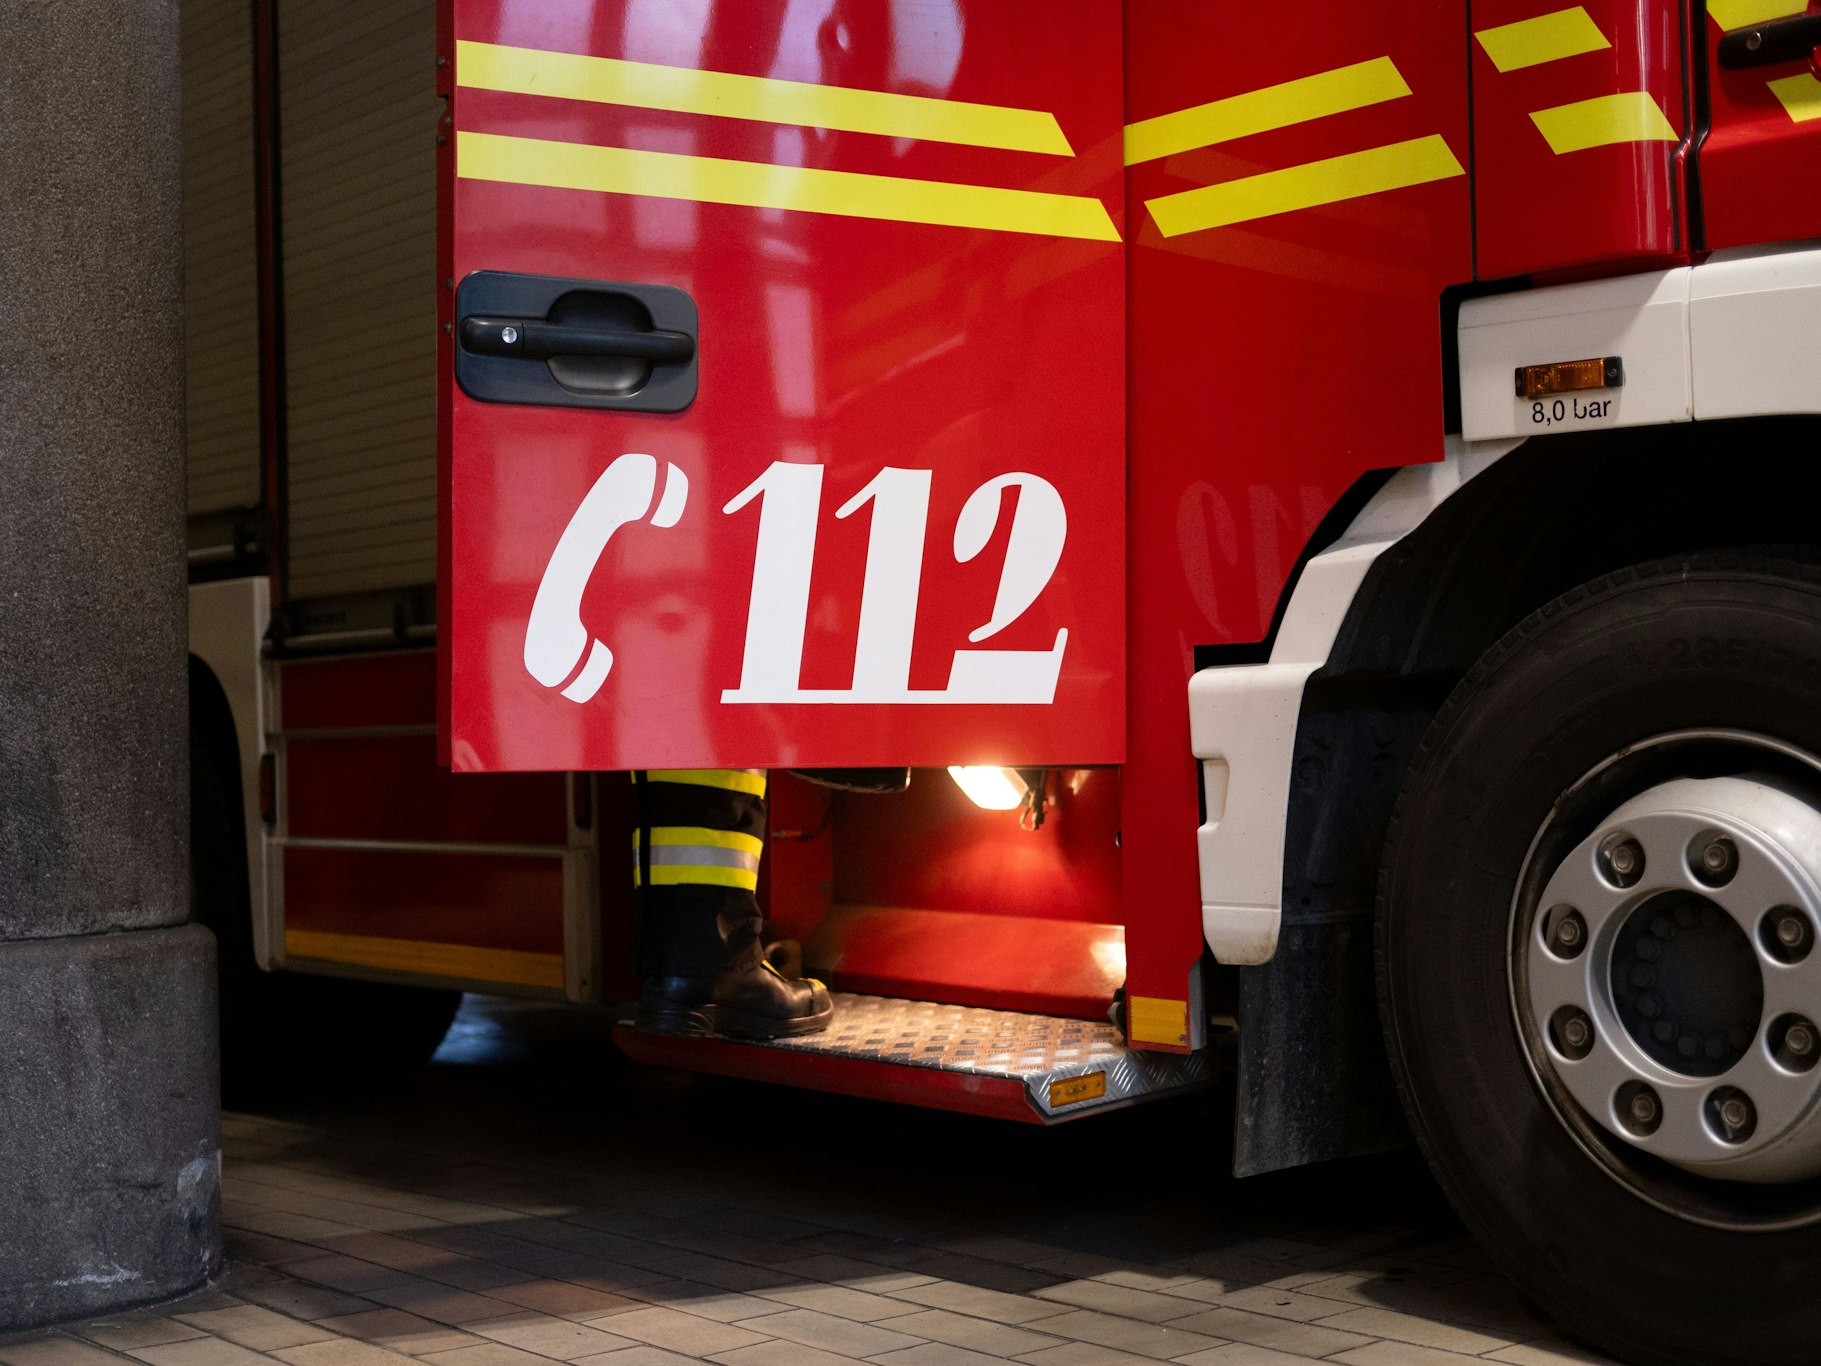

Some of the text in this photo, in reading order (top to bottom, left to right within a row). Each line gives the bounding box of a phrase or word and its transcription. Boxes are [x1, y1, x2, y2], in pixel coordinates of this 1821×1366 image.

[1532, 398, 1612, 426] 8,0 bar
[720, 461, 1069, 705] 112
